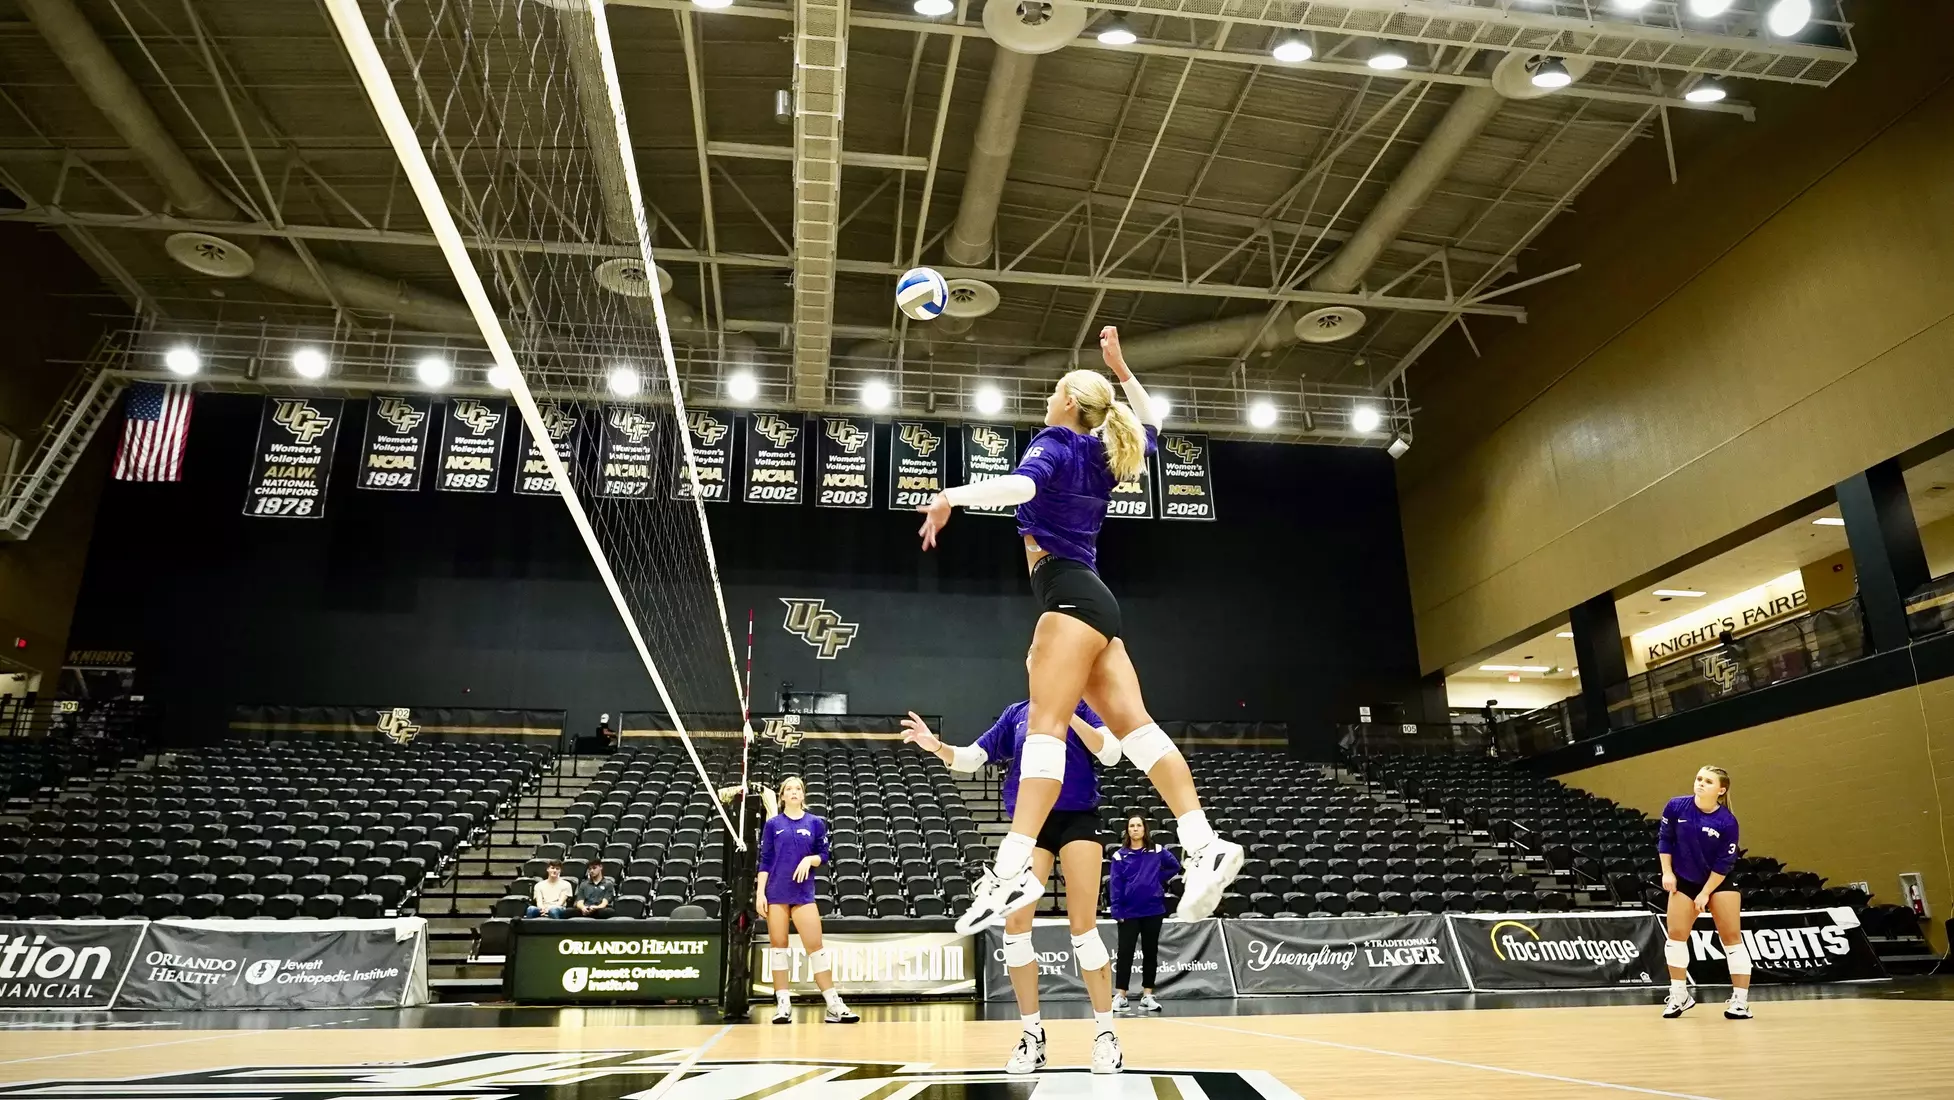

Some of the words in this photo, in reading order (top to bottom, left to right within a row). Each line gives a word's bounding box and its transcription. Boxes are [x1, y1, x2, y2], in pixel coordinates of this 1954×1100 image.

[275, 400, 331, 442] UCF
[378, 398, 423, 433] UCF
[455, 400, 499, 434] UCF
[688, 410, 726, 444] UCF
[755, 414, 797, 447] UCF
[378, 435, 418, 444] Women's
[455, 436, 494, 446] Women's
[826, 420, 867, 452] UCF
[901, 424, 939, 455] UCF
[972, 426, 1007, 455] UCF
[271, 443, 321, 454] Women's
[373, 443, 418, 453] Volleyball
[450, 444, 494, 454] Volleyball
[691, 448, 724, 456] omen's
[758, 451, 796, 459] Women's
[1166, 436, 1200, 462] UCF
[265, 454, 321, 465] Volleyball
[367, 454, 415, 469] NCAA
[445, 456, 491, 471] NCAA
[754, 459, 796, 467] Volleyball
[829, 455, 865, 463] Women's
[902, 459, 937, 467] Women's
[971, 455, 1008, 464] Women's
[264, 466, 316, 478] AIAW
[826, 463, 865, 472] Volleyball
[898, 466, 938, 475] Volleyball
[970, 462, 1009, 471] Volleyball
[1165, 469, 1204, 477] Volleyball
[1166, 462, 1202, 471] Women's
[366, 471, 412, 487] 1994
[445, 472, 490, 488] 1995
[751, 469, 795, 483] NCAA
[822, 474, 865, 488] NCAA
[897, 476, 939, 490] NCAA
[262, 479, 316, 488] NATIONAL
[1168, 485, 1203, 495] NCAA
[254, 487, 319, 496] CHAMPIONS
[748, 486, 798, 500] 2002
[820, 490, 868, 504] 2003
[254, 497, 314, 515] 1978
[1107, 500, 1147, 514] 2019
[1167, 502, 1208, 515] 2020
[781, 600, 857, 657] UCF
[1648, 616, 1735, 660] KNIGHT'S
[1742, 589, 1807, 626] FAIRE
[1701, 656, 1737, 691] UCF
[62, 702, 79, 711] 101
[395, 709, 408, 717] 102
[786, 716, 799, 724] 103
[378, 712, 420, 744] UCF
[764, 718, 803, 748] UCF
[1403, 724, 1417, 733] 105
[1728, 843, 1736, 854] 3
[558, 939, 640, 954] ORLANDO
[641, 939, 704, 954] HEALTH
[1690, 924, 1850, 961] KIGHTS
[993, 949, 1069, 962] ONDO
[1248, 940, 1357, 971] Yuengling
[1371, 938, 1432, 948] TRADITIONAL
[1365, 946, 1445, 967] LAGER
[1502, 935, 1540, 961] fbc
[1537, 936, 1640, 965] mortgage
[145, 951, 237, 971] ORLANDO
[281, 959, 323, 970] Jewett
[1176, 959, 1218, 972] Institute
[1751, 958, 1832, 969] LLEYBALL
[147, 967, 222, 985] HEALTH
[276, 970, 351, 985] Orthopedic
[352, 967, 399, 981] Institute
[590, 967, 630, 978] Jewett
[631, 966, 700, 980] Orthopedic
[588, 979, 639, 991] Institute
